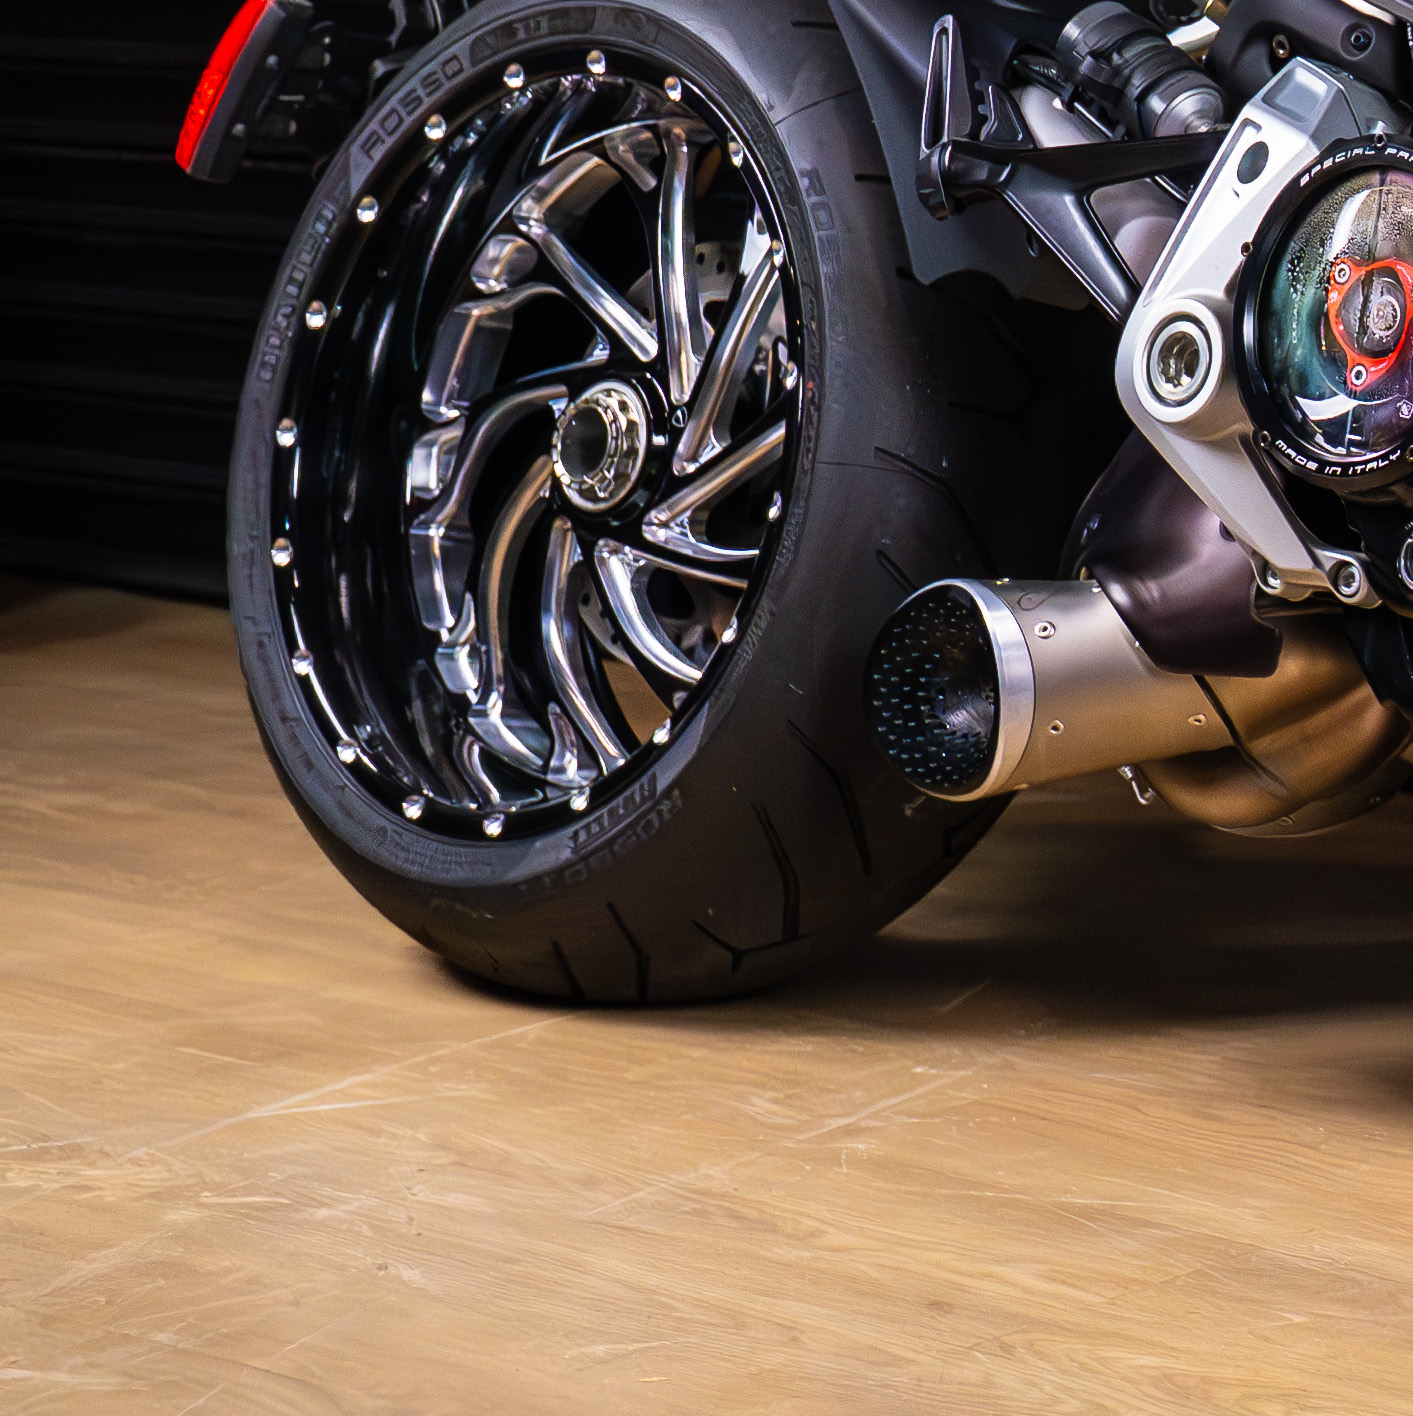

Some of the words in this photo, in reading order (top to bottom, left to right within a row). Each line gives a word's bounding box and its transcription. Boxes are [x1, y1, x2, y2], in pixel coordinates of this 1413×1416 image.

[361, 50, 466, 164] ROSSO
[1299, 145, 1375, 187] SPECIAL
[1275, 439, 1318, 471] MADE
[1325, 465, 1341, 476] IN
[1348, 449, 1402, 476] ITALY
